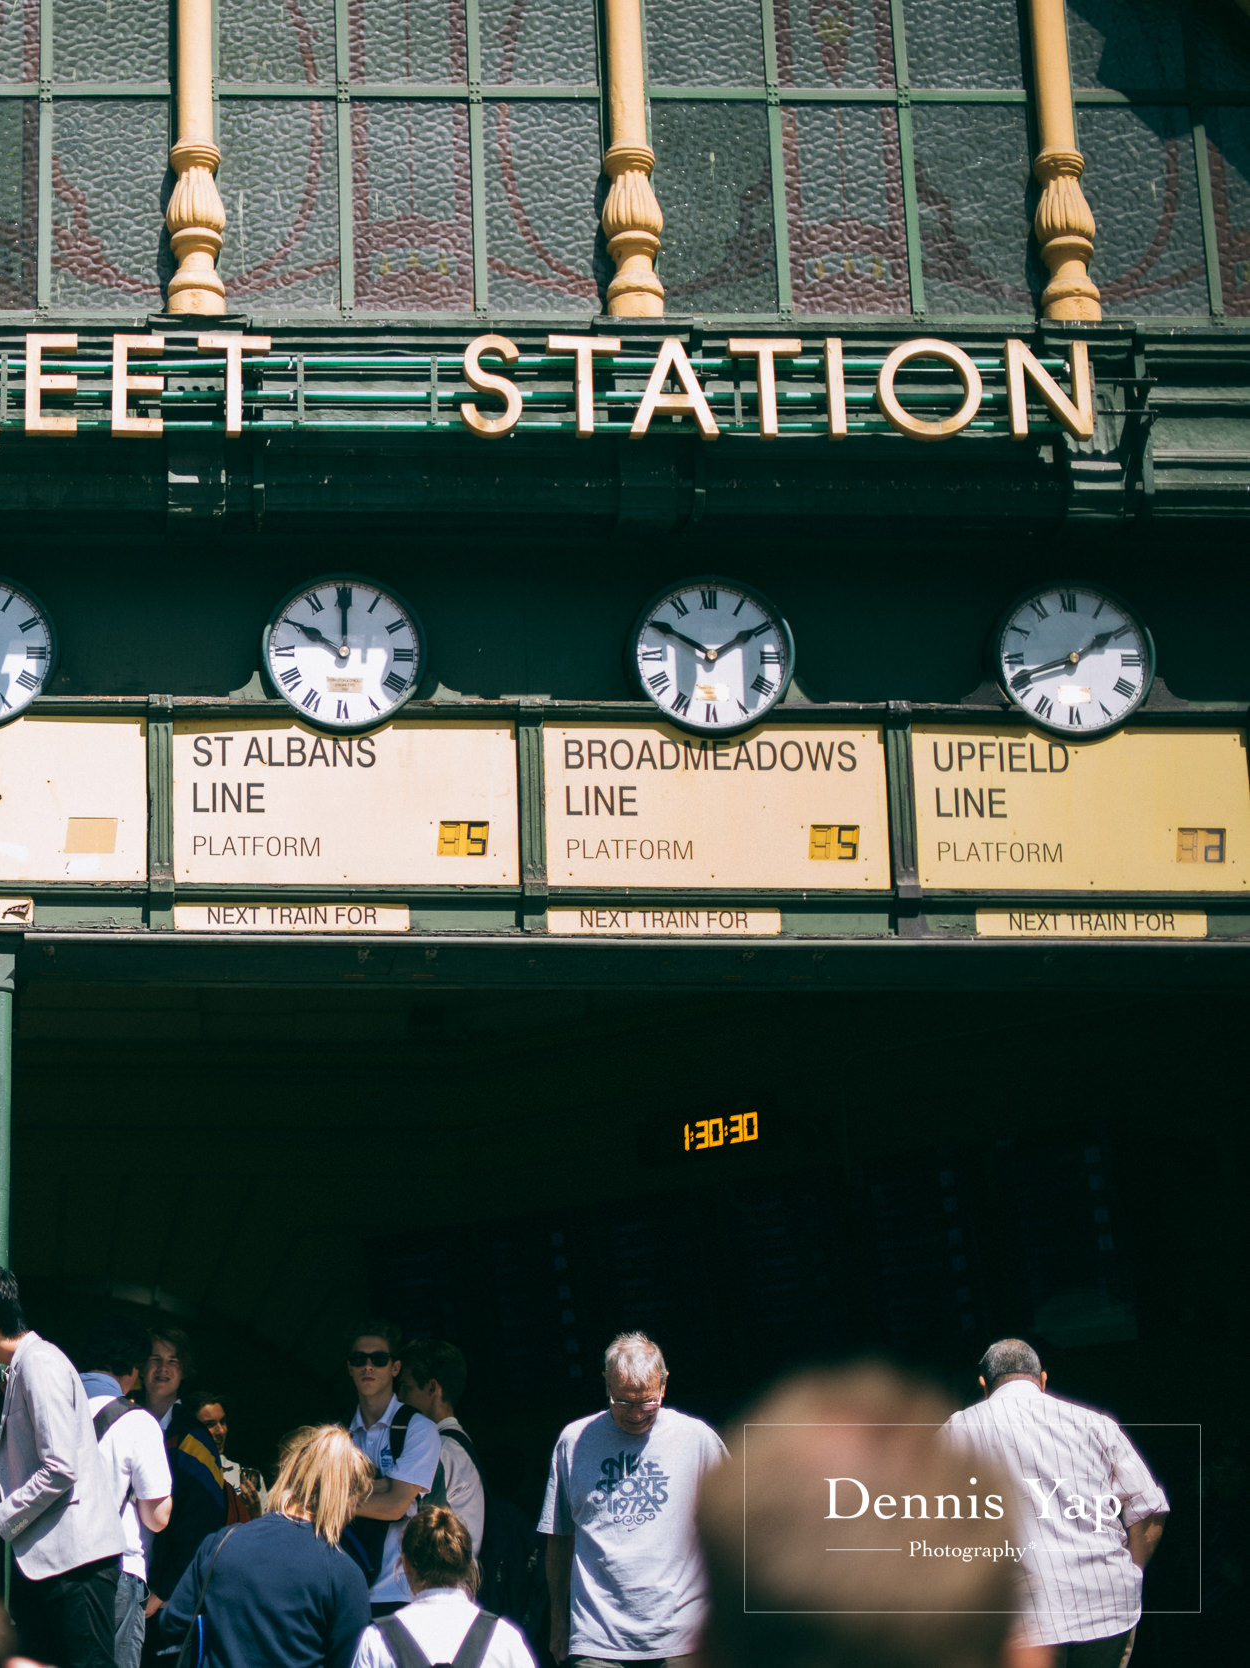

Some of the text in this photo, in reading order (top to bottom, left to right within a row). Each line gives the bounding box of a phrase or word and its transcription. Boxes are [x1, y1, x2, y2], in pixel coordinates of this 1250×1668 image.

[460, 334, 1095, 442] STATION
[193, 736, 376, 768] ST ALBANS
[564, 739, 857, 771] BROADMEADOWS
[933, 741, 1069, 773] UPFIELD
[193, 783, 265, 813] LINE
[566, 786, 638, 816] LINE
[936, 788, 1007, 818] LINE
[193, 836, 321, 857] PLATFORM
[567, 839, 693, 860] PLATFORM
[938, 842, 1063, 863] PLATFORM
[207, 907, 376, 925] NEXT TRAIN FOR
[580, 911, 748, 929] NEXT TRAIN FOR
[1009, 913, 1175, 931] NEXT TRAIN FOR
[684, 1111, 759, 1152] 1:30:30
[601, 1450, 664, 1480] NIKE
